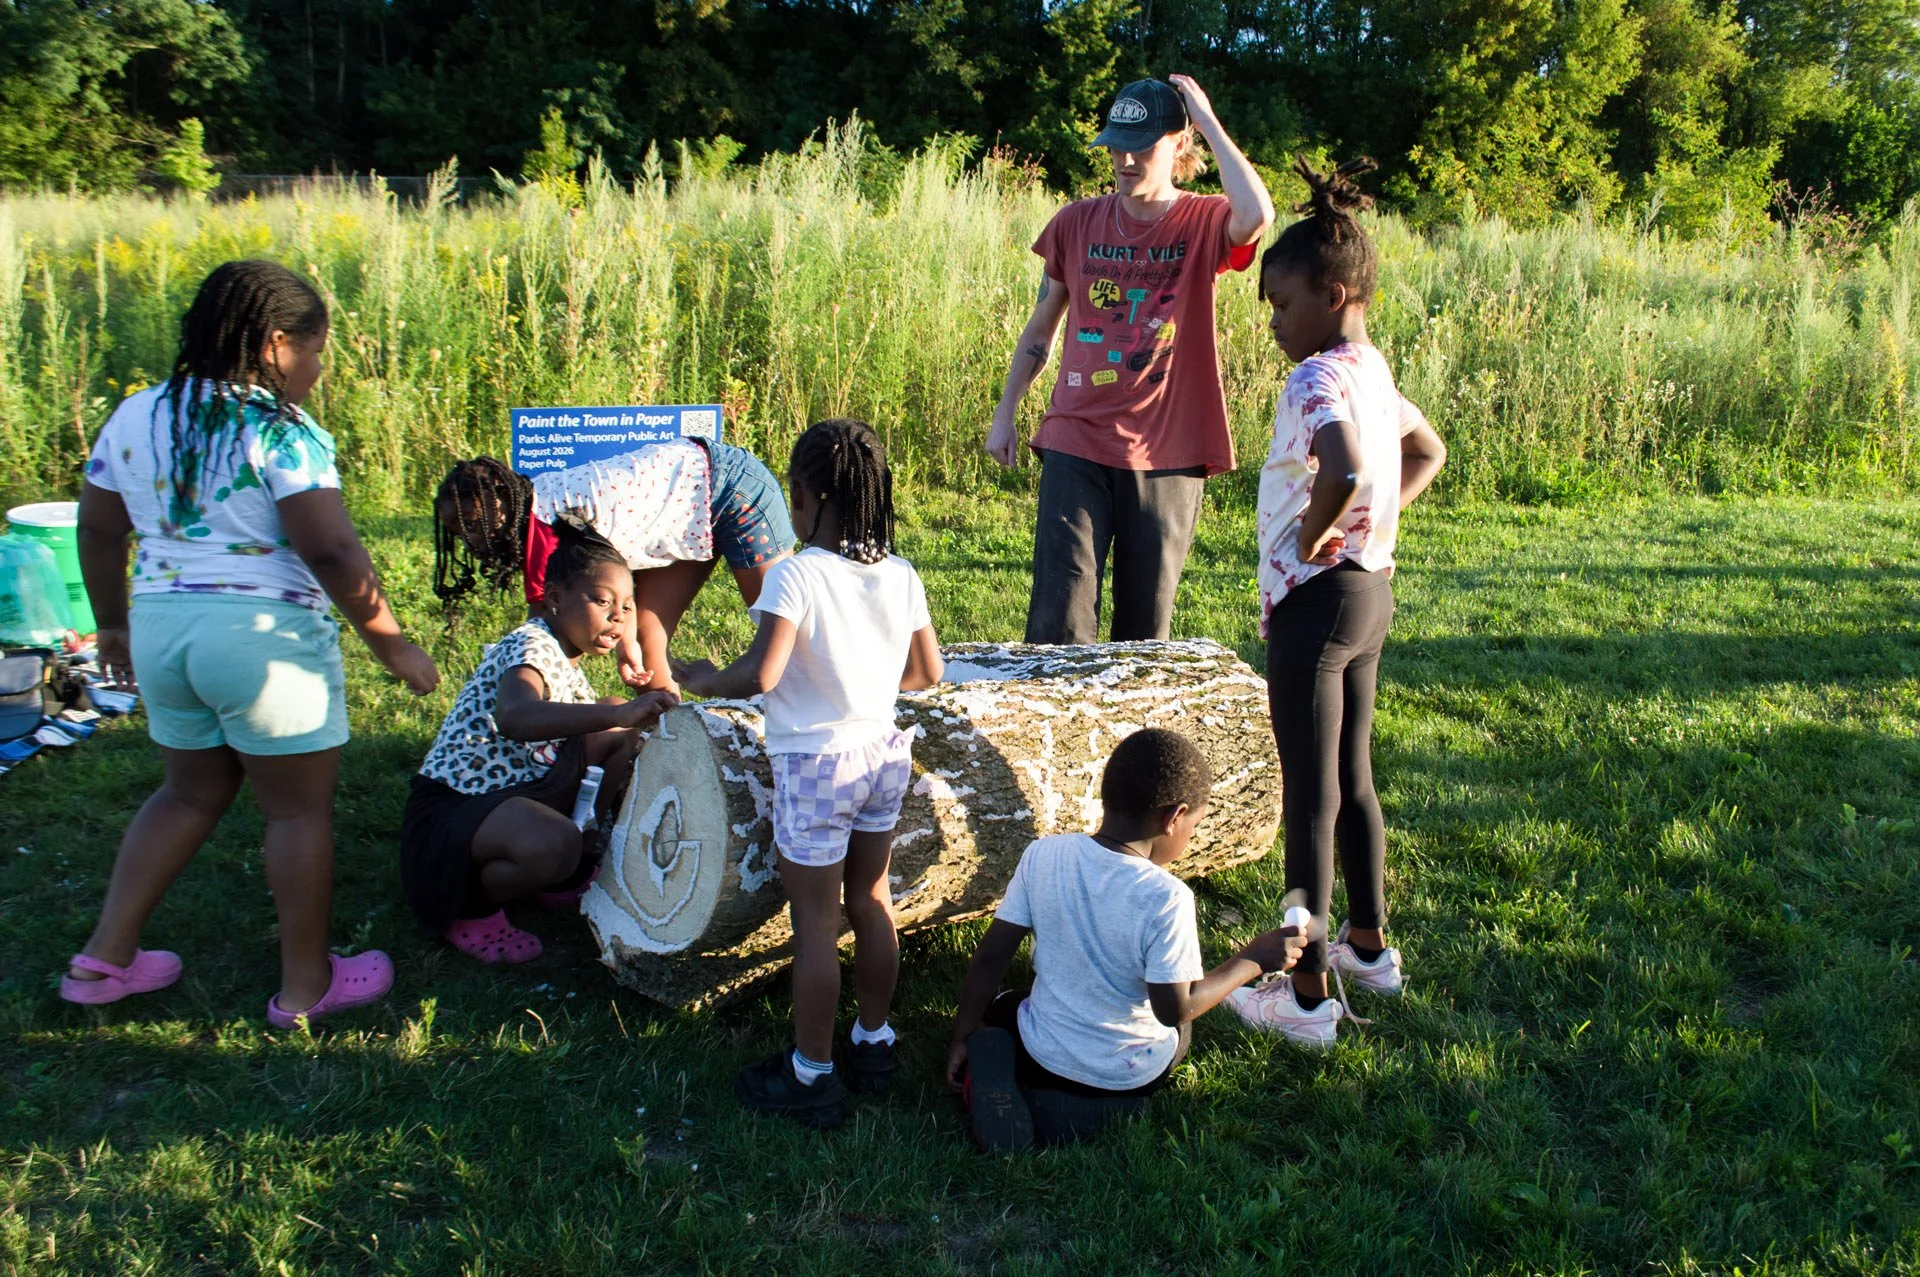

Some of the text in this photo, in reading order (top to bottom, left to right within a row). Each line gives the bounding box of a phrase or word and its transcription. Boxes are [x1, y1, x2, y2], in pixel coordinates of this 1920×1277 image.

[1087, 240, 1187, 263] KURT VILE
[1093, 280, 1118, 295] LIFE
[518, 412, 675, 428] Paint the Town in Paper
[518, 430, 675, 444] Parks Alive Temporary Public Art
[518, 446, 575, 458] August 2026
[518, 458, 567, 470] Paper Pulp
